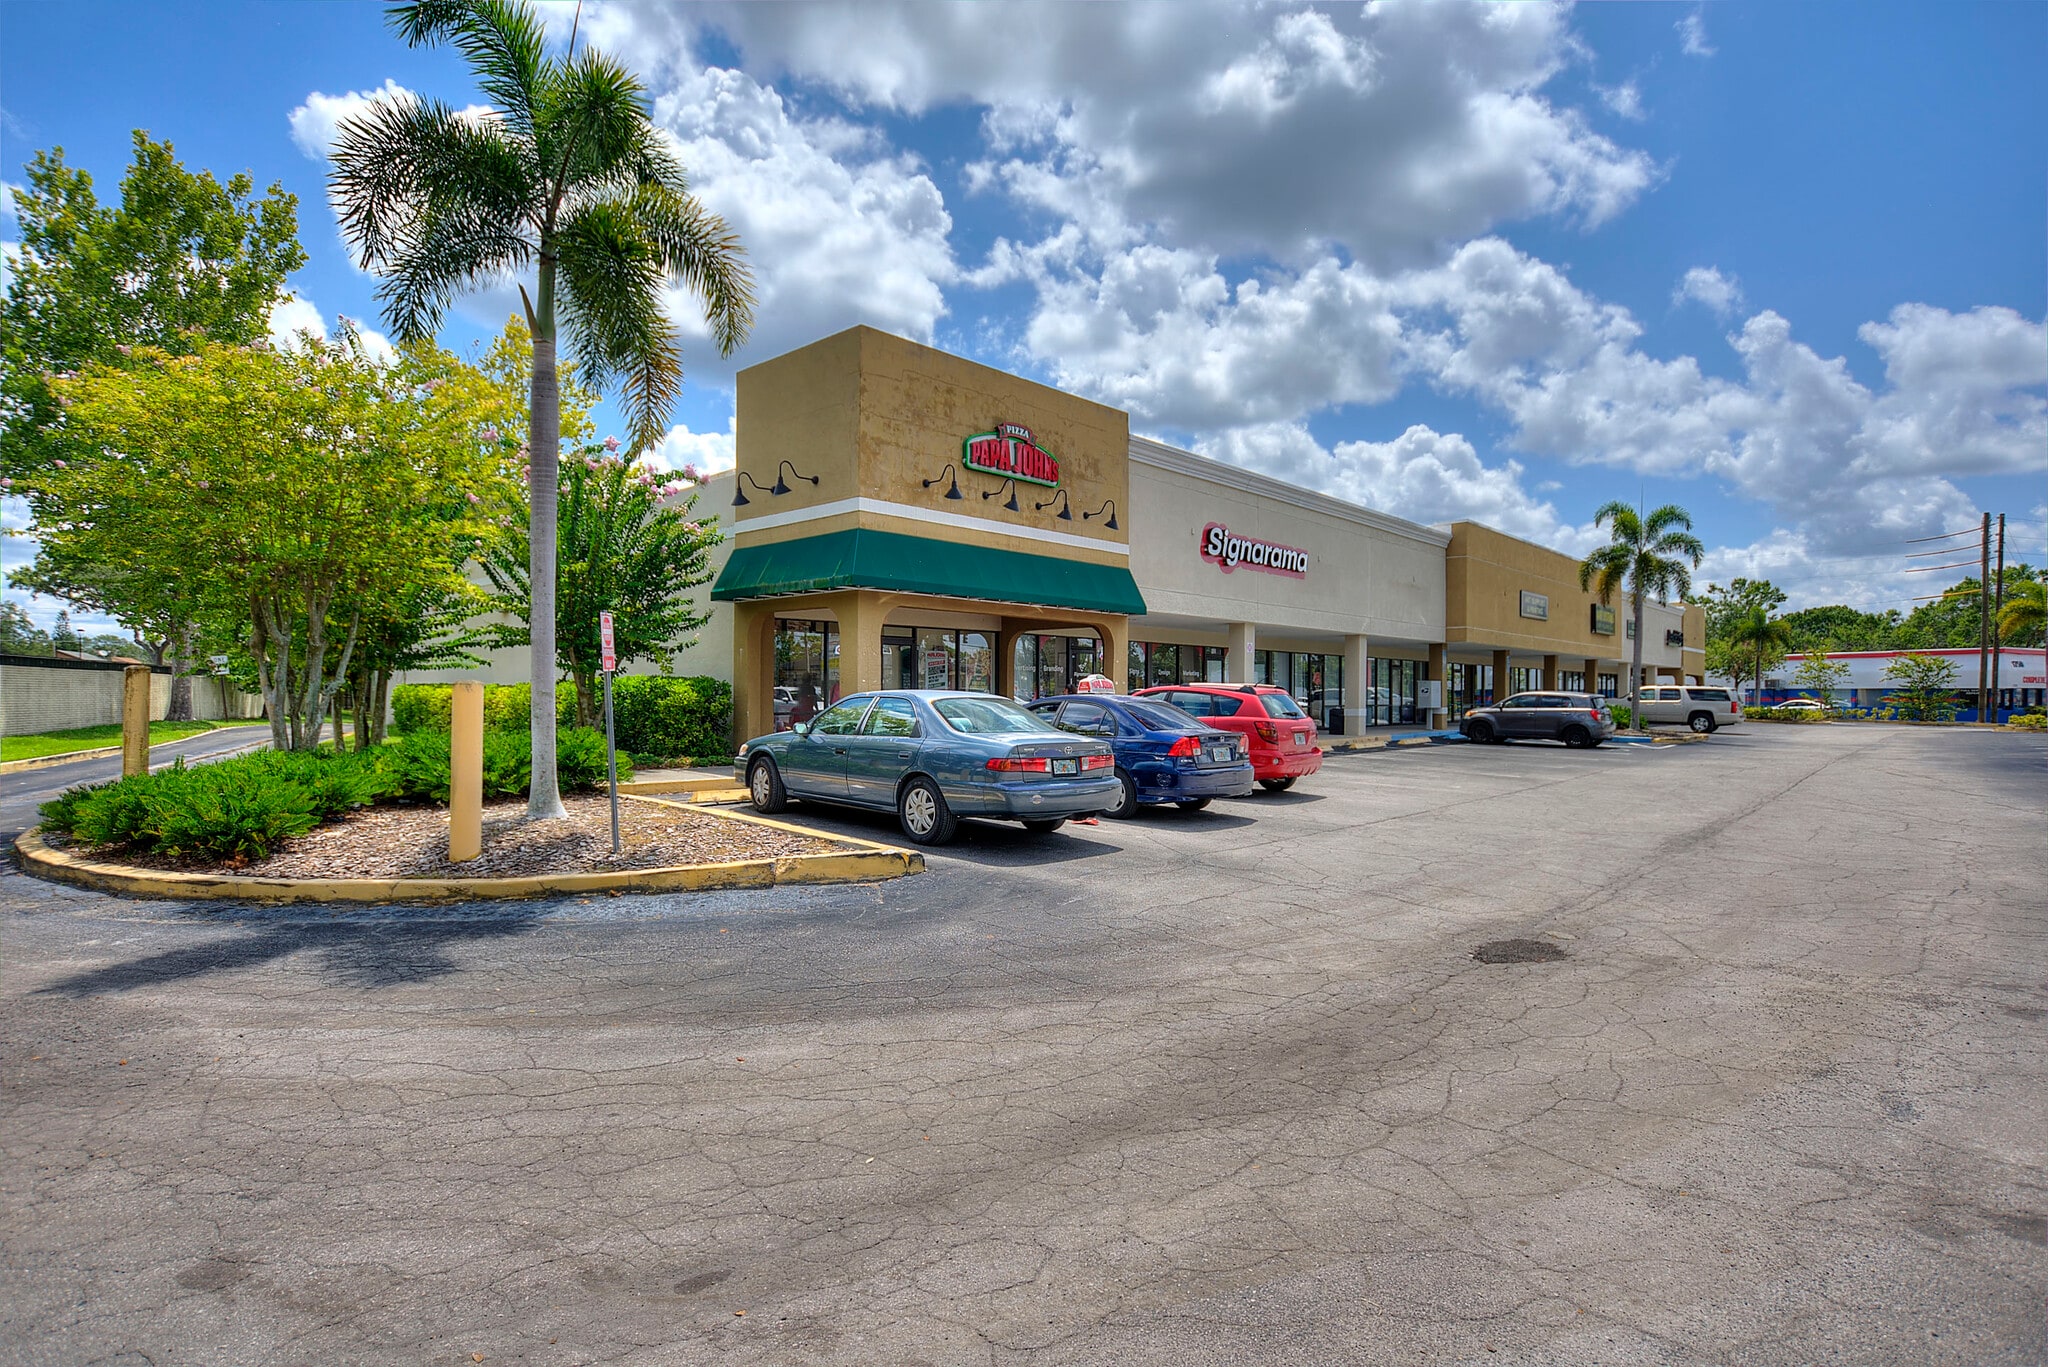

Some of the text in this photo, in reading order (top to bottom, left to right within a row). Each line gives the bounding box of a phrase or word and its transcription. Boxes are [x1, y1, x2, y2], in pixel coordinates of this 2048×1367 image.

[1006, 424, 1029, 439] PIZZA
[971, 438, 1059, 482] PAPA JOHNS
[1208, 527, 1308, 572] Signarama
[1043, 665, 1064, 673] Branding
